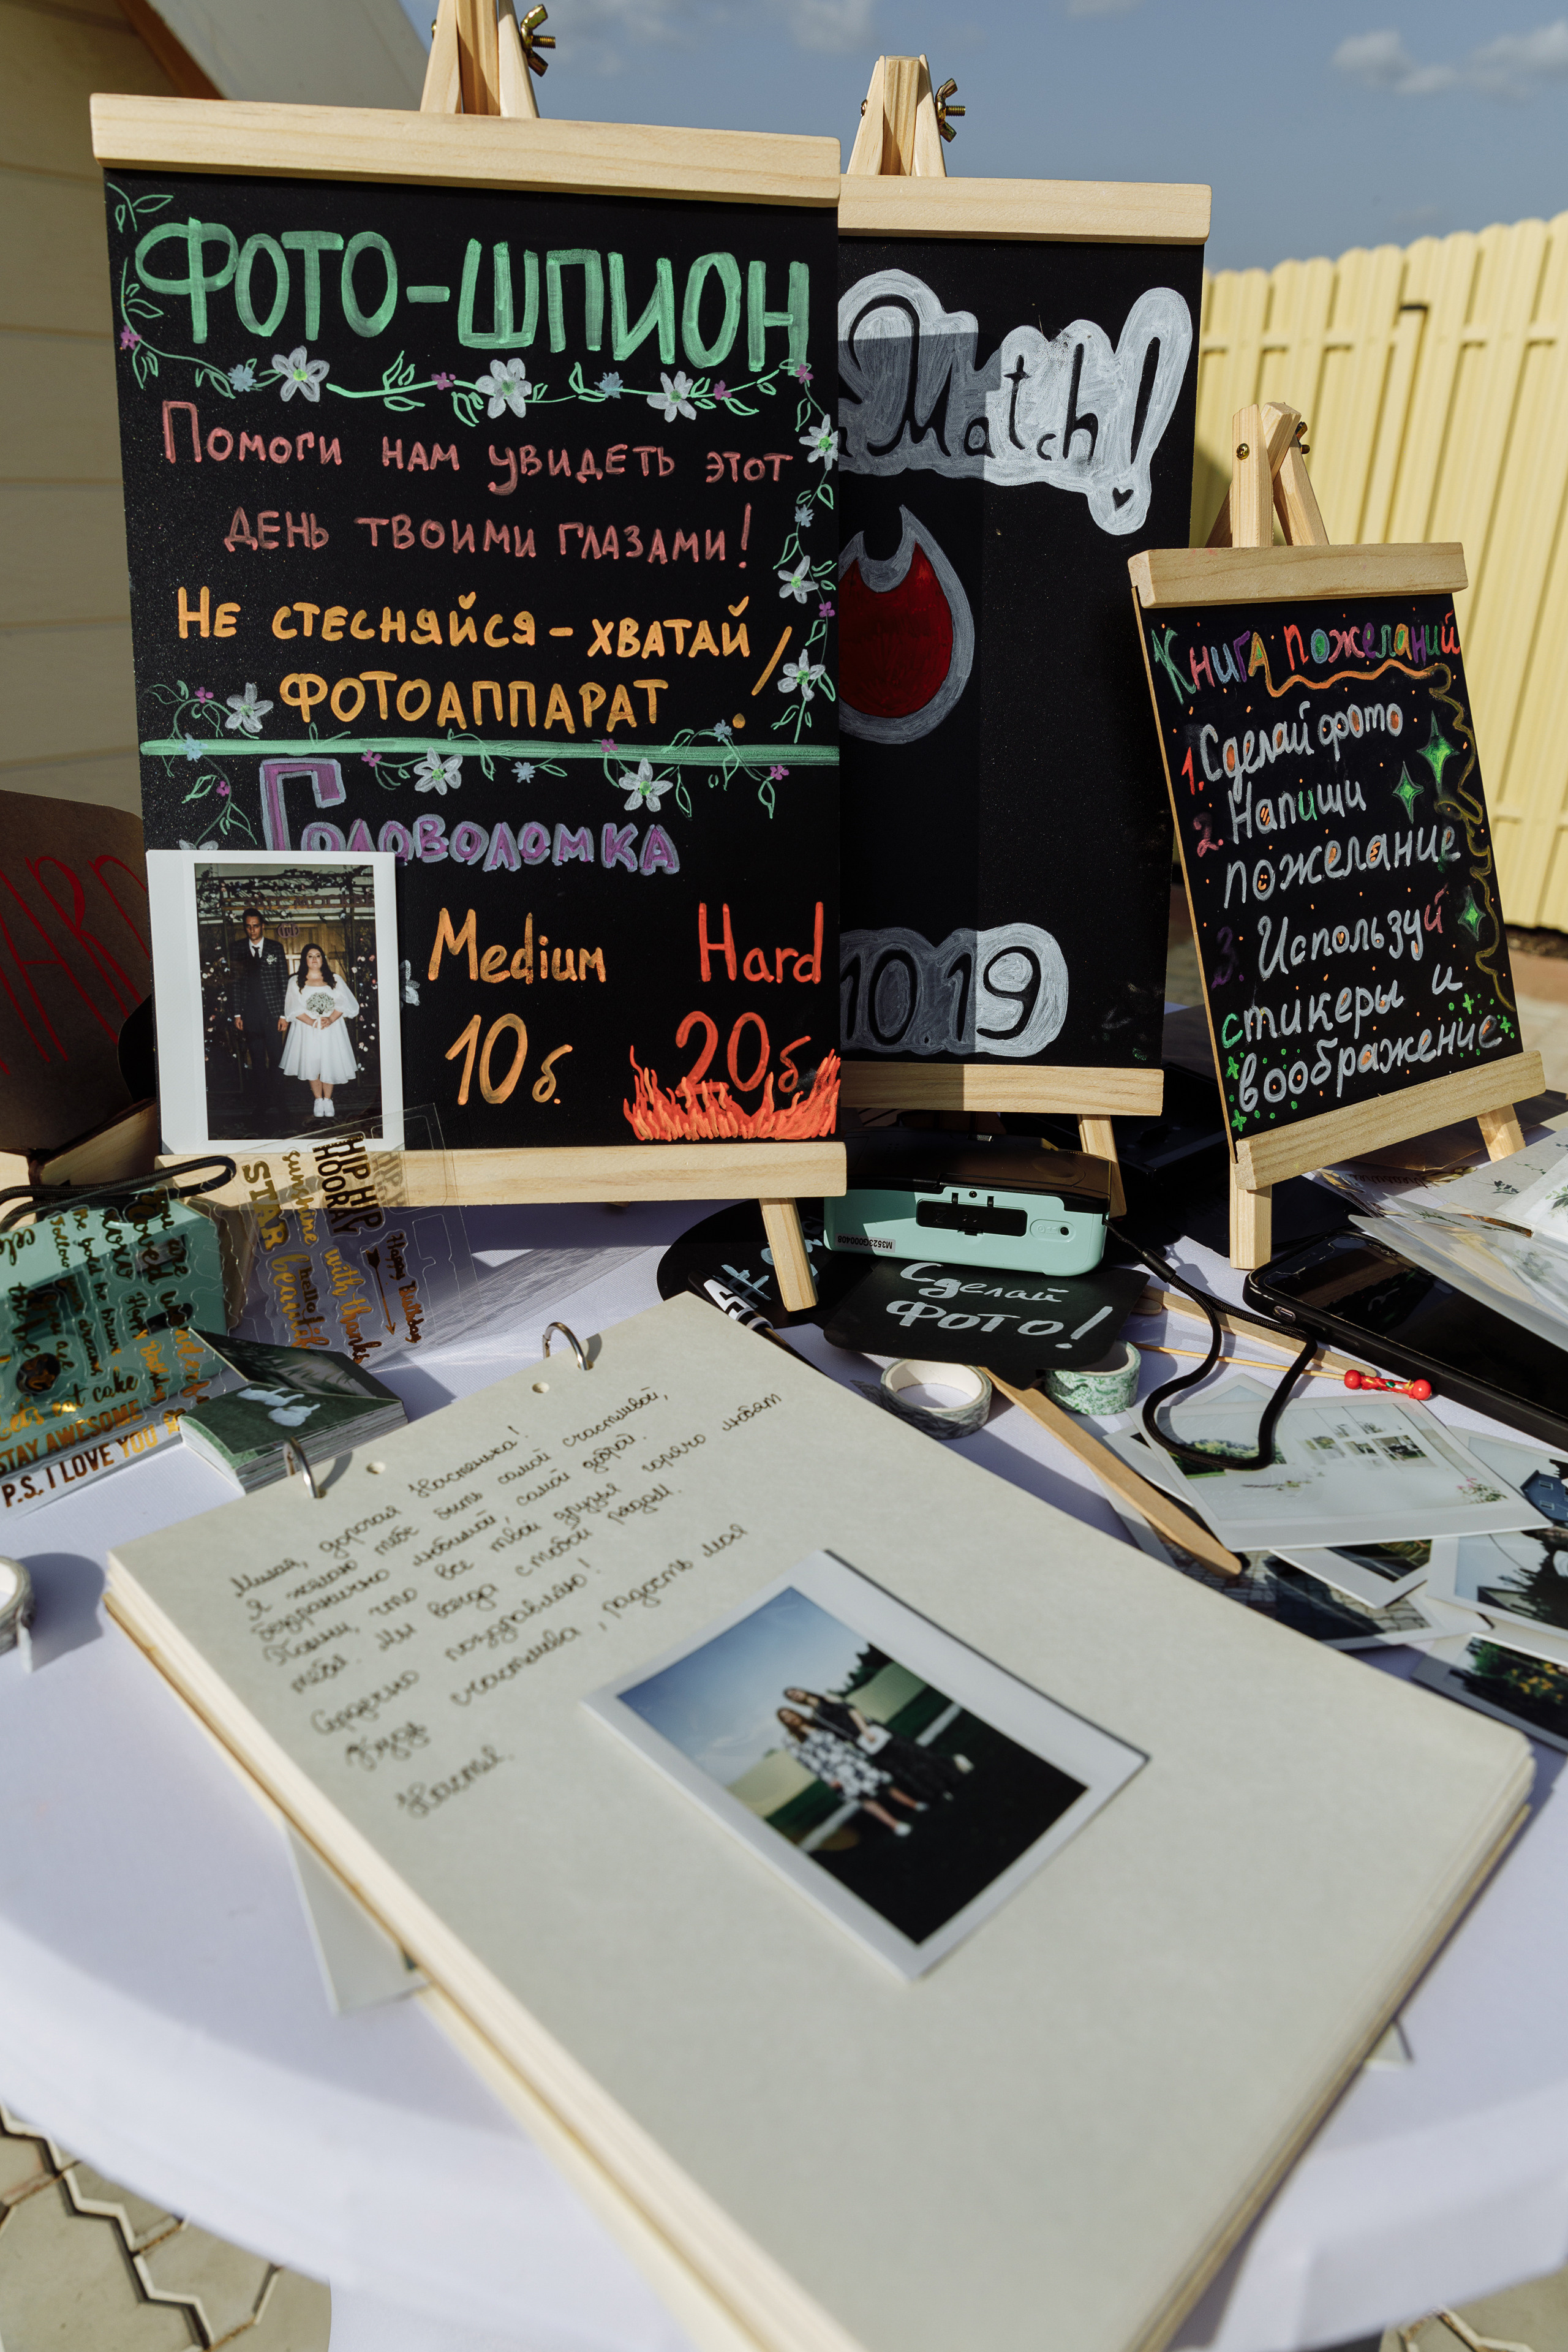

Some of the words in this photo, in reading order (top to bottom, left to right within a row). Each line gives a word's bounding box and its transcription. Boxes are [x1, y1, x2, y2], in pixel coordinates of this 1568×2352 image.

[135, 217, 809, 375] ФОТО-ШПИОН
[1200, 701, 1314, 803] Сделай
[1318, 703, 1403, 761] фото
[1227, 780, 1366, 844] Напиши
[1223, 825, 1461, 908] пожелание
[429, 907, 606, 984] Medium
[698, 902, 824, 983] Hard
[1259, 883, 1450, 981] Используй
[1222, 980, 1404, 1048] стикеры
[1431, 963, 1463, 995] и
[1238, 1014, 1502, 1112] воображение
[242, 1161, 288, 1251] STAR
[282, 1150, 318, 1246] sunshine
[312, 1147, 360, 1234] HOORAY
[271, 1253, 330, 1349] beautif
[324, 1248, 365, 1297] with
[900, 1262, 1069, 1303] Сделай
[339, 1292, 383, 1365] thanks
[92, 1365, 140, 1403] cake
[1, 1476, 45, 1508] P.S.
[46, 1467, 57, 1490] I
[59, 1442, 115, 1484] LOVE
[116, 1424, 159, 1459] YOU
[45, 1398, 143, 1457] AWESOME
